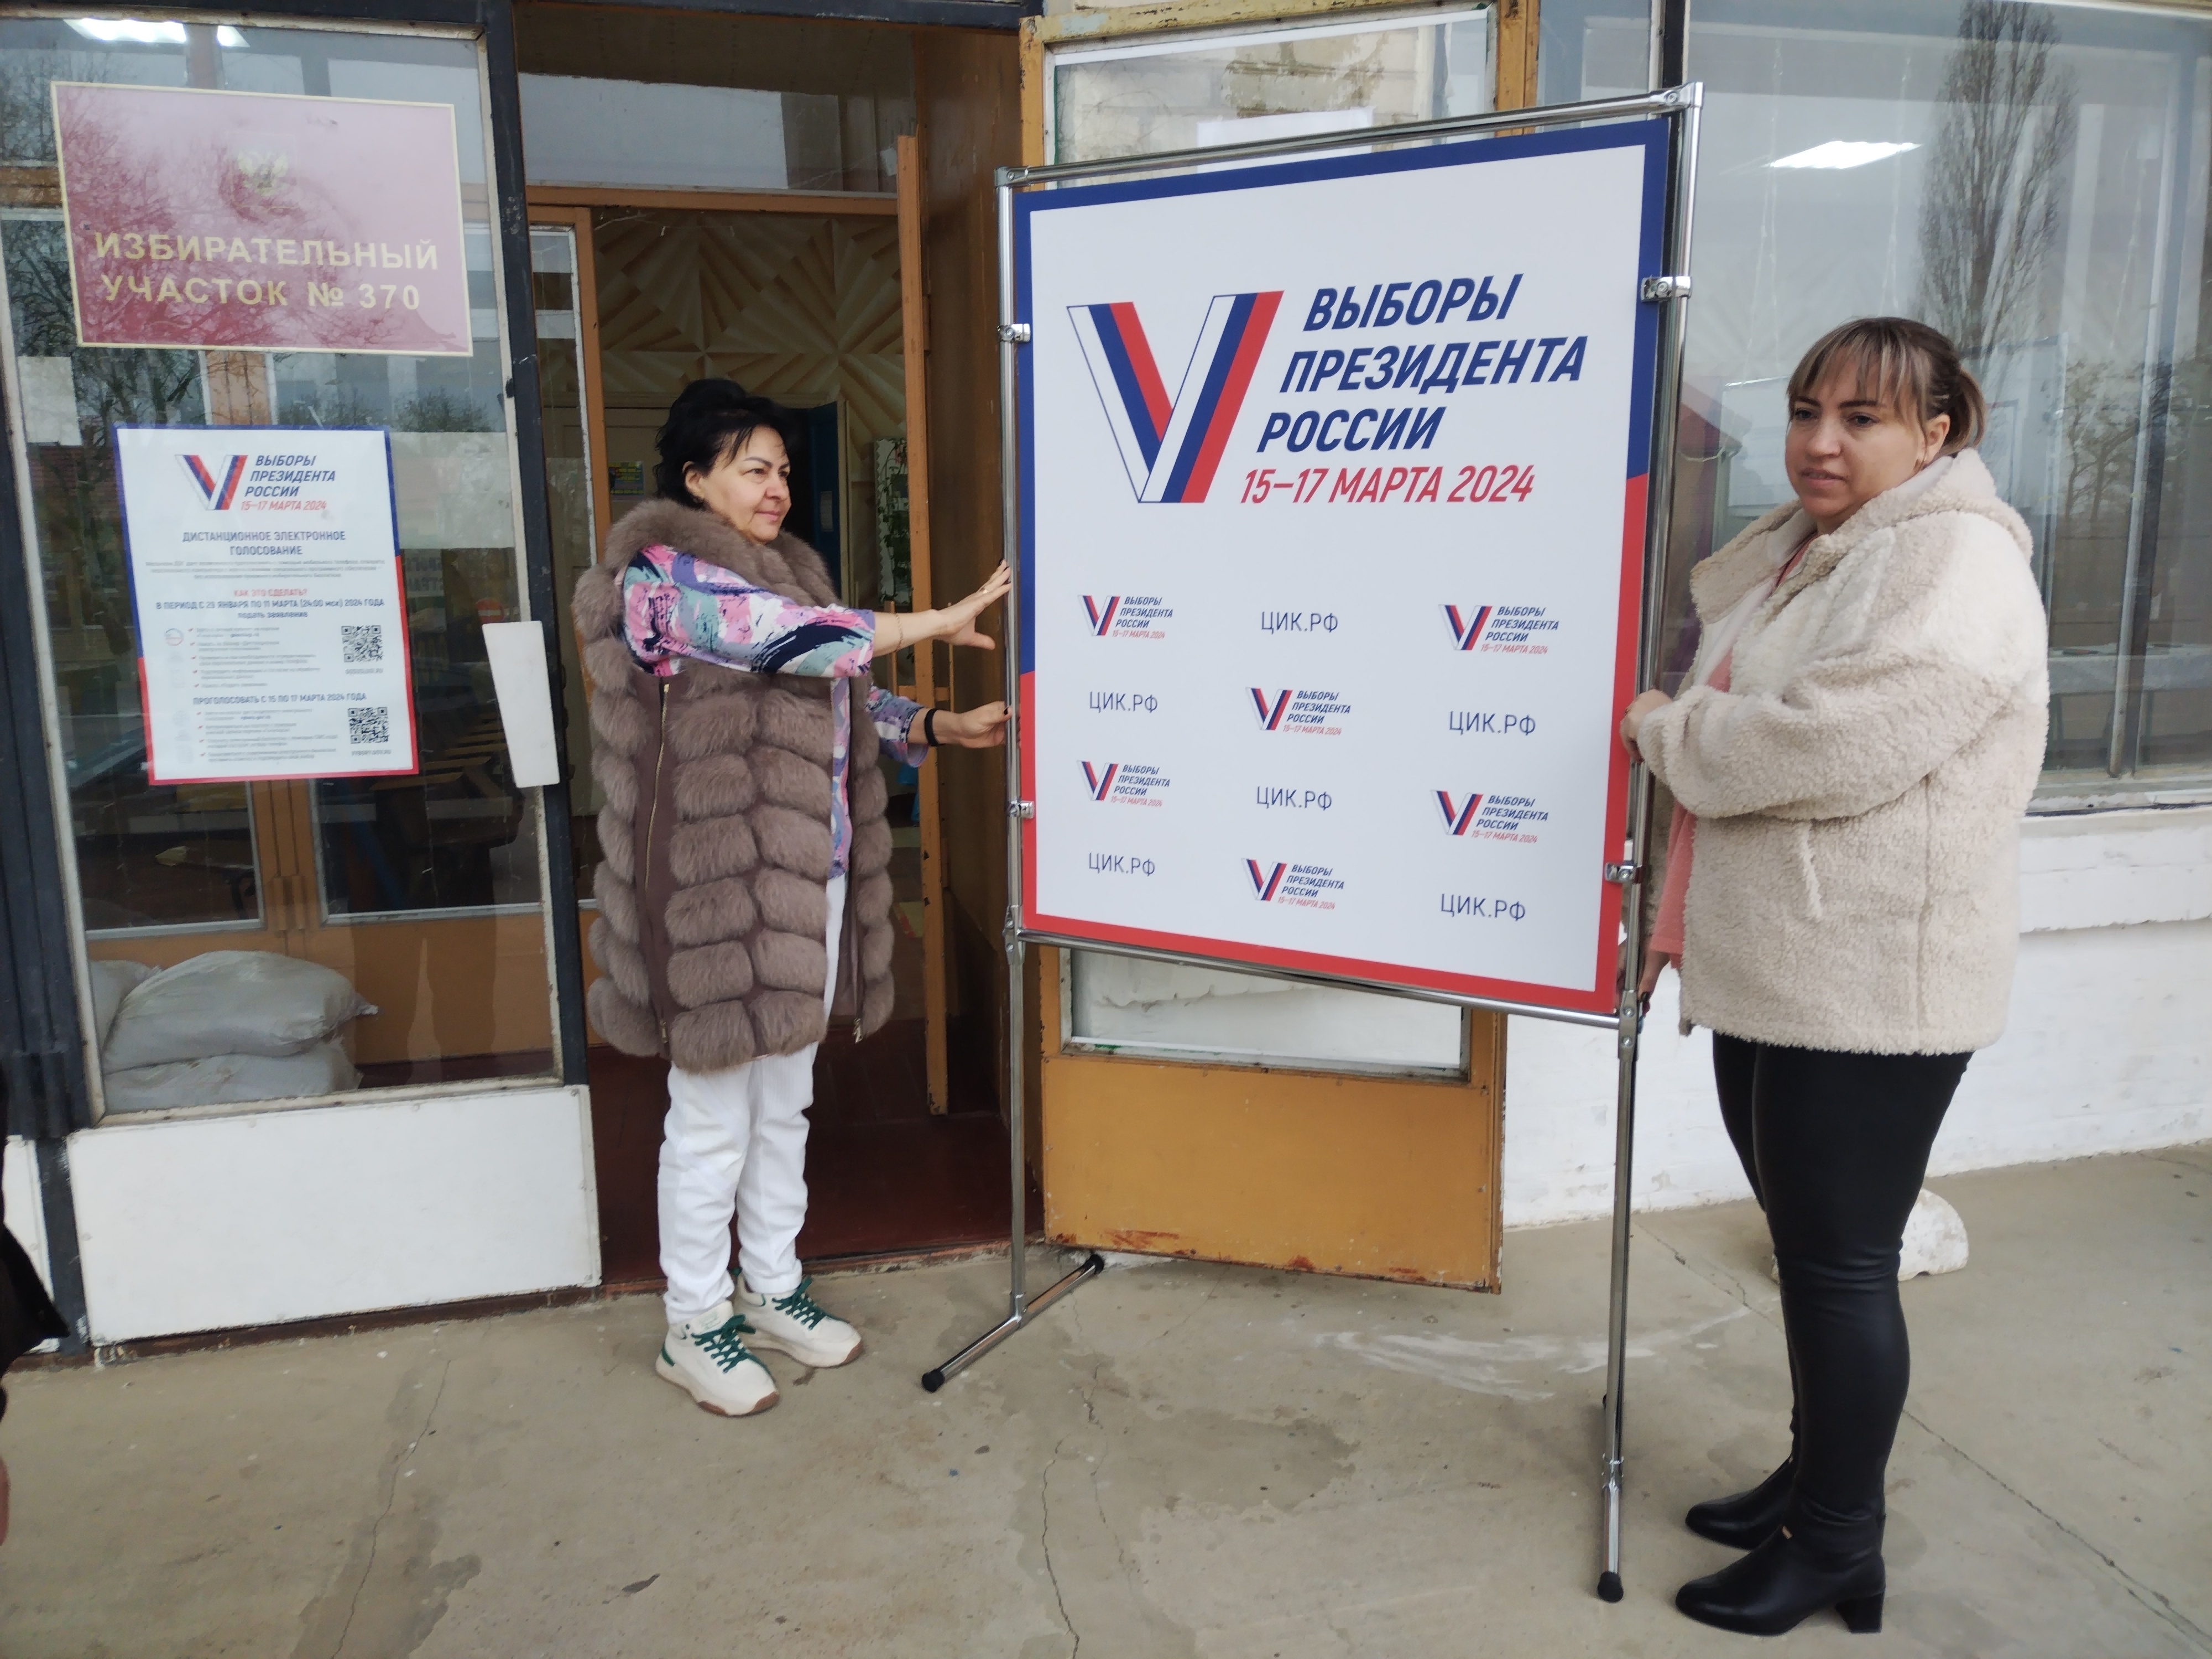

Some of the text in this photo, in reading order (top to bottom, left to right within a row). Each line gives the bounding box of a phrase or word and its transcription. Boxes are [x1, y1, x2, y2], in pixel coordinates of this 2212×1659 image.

[96, 232, 438, 270] ИЗБИРАТЕЛЬНЫЙ
[102, 275, 420, 310] УЧАСТОК № 370
[1302, 273, 1524, 332] ВЫБОРЫ
[1279, 335, 1588, 394] ПРЕЗИДЕНТА
[1256, 407, 1446, 453] РОССИИ
[255, 455, 317, 466] ВЫБОРЫ
[250, 471, 336, 483] ПРЕЗИДЕНТА
[1328, 467, 1444, 503] МАРТА
[1446, 465, 1535, 503] 2024
[244, 486, 300, 497] РОССИИ
[269, 500, 301, 510] МАРТА
[303, 500, 327, 510] 2024
[182, 531, 346, 542] ДИСТАНЦИОННОЕ ЭЛЕКТРОННОЕ
[230, 546, 302, 555] ГОЛОСОВАНИЕ
[164, 601, 197, 609] ПЕРИОД
[364, 598, 385, 607] ГОДА
[1124, 597, 1162, 606] ВЫБОРЫ
[1119, 608, 1173, 618] ПРЕЗИДЕНТА
[1497, 606, 1546, 617] ВЫБОРЫ
[1115, 619, 1150, 628] РОССИИ
[1261, 612, 1338, 634] ЦИК.РФ
[1491, 619, 1559, 631] ПРЕЗИДЕНТА
[1485, 632, 1530, 642] РОССИИ
[1502, 644, 1528, 654] МАРТА
[1528, 645, 1548, 655] 2024
[299, 694, 325, 702] МАРТА
[347, 693, 367, 701] ГОДА
[1089, 691, 1158, 713] ЦИК.РФ
[1297, 691, 1339, 701] ВЫБОРЫ
[1292, 702, 1351, 714] ПРЕЗИДЕНТА
[1286, 713, 1325, 724] РОССИИ
[1449, 711, 1536, 735] ЦИК.РФ
[1301, 726, 1323, 734] МАРТА
[1325, 727, 1342, 735] 2024
[1122, 764, 1160, 775] ВЫБОРЫ
[1118, 775, 1171, 787] ПРЕЗИДЕНТА
[1114, 785, 1147, 796] РОССИИ
[1127, 796, 1147, 806] МАРТА
[1147, 799, 1163, 807] 2024
[1256, 786, 1332, 811] ЦИК.РФ
[1487, 795, 1536, 807] ВЫБОРЫ
[1481, 807, 1549, 821] ПРЕЗИДЕНТА
[1475, 818, 1519, 831] РОССИИ
[1493, 831, 1518, 842] МАРТА
[1519, 834, 1538, 844] 2024
[1088, 852, 1155, 877] ЦИК.РФ
[1291, 864, 1333, 877] ВЫБОРЫ
[1286, 875, 1345, 890] ПРЕЗИДЕНТА
[1281, 885, 1319, 898] РОССИИ
[1296, 898, 1318, 908] МАРТА
[1318, 901, 1335, 910] 2024
[1441, 893, 1526, 921] ЦИК.РФ
